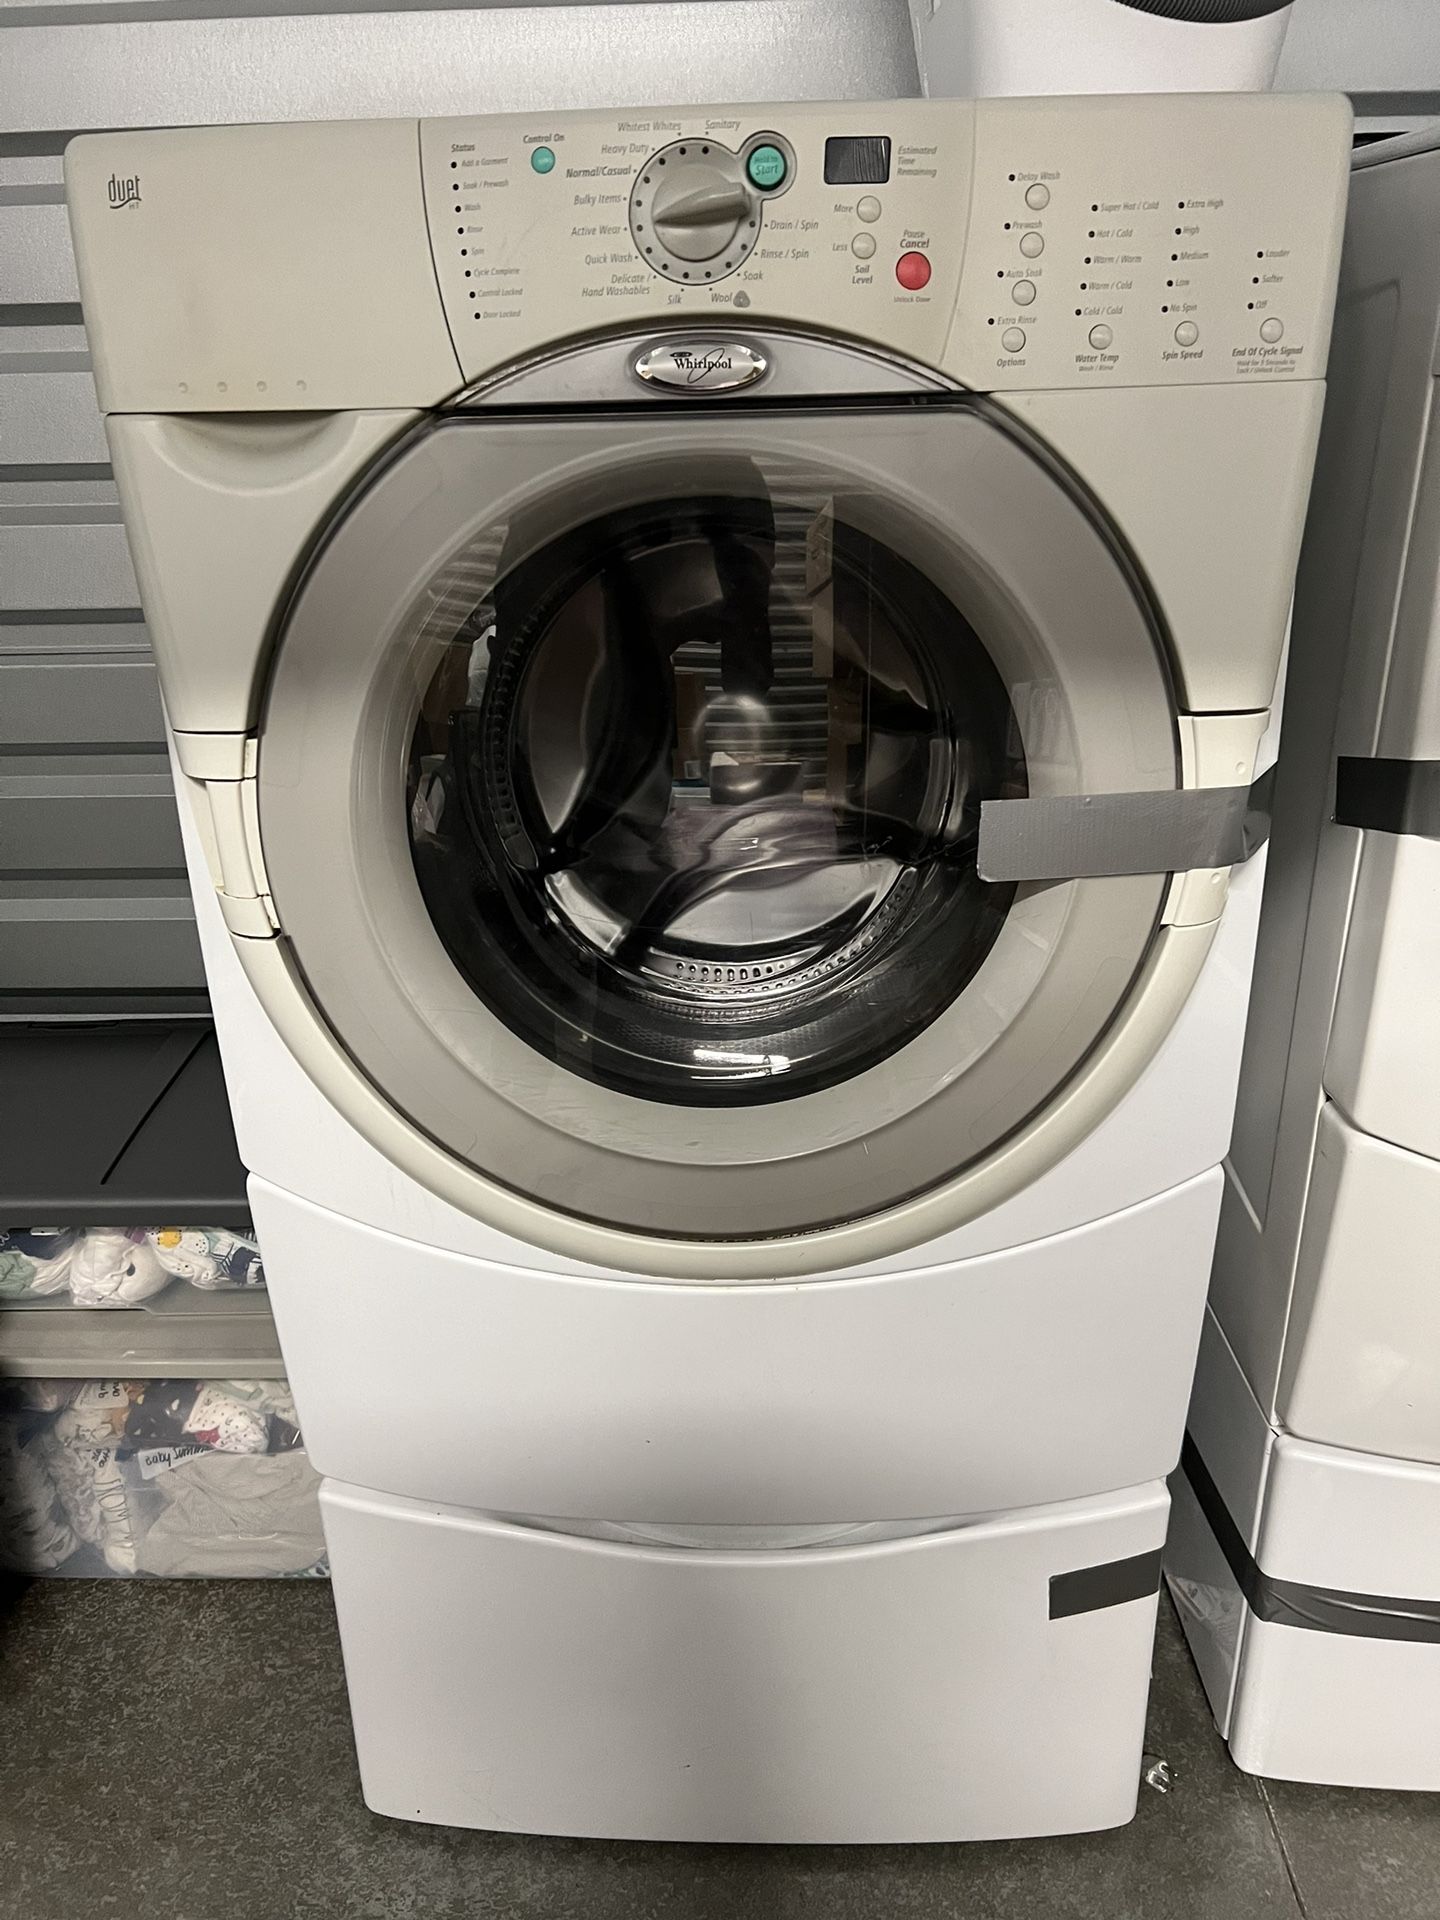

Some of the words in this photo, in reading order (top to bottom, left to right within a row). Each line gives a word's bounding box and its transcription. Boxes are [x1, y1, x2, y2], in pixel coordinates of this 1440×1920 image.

[618, 122, 650, 132] Whitest
[653, 120, 682, 132] Whites
[705, 120, 741, 131] Sanitary
[523, 134, 552, 144] Control
[553, 133, 566, 142] On
[451, 144, 475, 153] Status
[601, 144, 627, 155] Heavy
[629, 143, 650, 154] Duty
[898, 145, 938, 155] Estimated
[566, 165, 632, 178] Normal/Casual
[755, 164, 778, 176] Start
[897, 168, 938, 178] Remaining
[108, 173, 140, 203] duet
[574, 195, 596, 206] Bulky
[598, 194, 622, 204] Items
[1186, 200, 1206, 208] Extra
[1206, 200, 1224, 210] High
[833, 204, 854, 213] More
[1100, 203, 1122, 213] Super
[1122, 202, 1136, 211] Hot
[1142, 201, 1160, 210] Cold
[770, 220, 793, 230] Drain
[800, 219, 819, 232] Spin
[571, 226, 597, 236] Active
[599, 226, 622, 236] Wear
[903, 229, 926, 238] Pause
[1096, 230, 1110, 238] Hot
[1116, 228, 1134, 238] Cold
[832, 243, 848, 252] Less
[900, 238, 930, 249] Cancel
[760, 248, 784, 259] Rinse
[790, 248, 810, 260] Spin
[1180, 252, 1209, 260] Medium
[585, 254, 607, 266] Quick
[610, 253, 633, 264] Wash
[1094, 256, 1114, 264] Warm
[1120, 255, 1142, 264] Warm
[474, 268, 490, 278] Cycle
[490, 268, 520, 276] Complete
[854, 264, 870, 274] Soil
[611, 274, 645, 284] Delicate
[743, 270, 764, 281] Soak
[852, 275, 874, 285] Level
[1088, 282, 1110, 290] Warm
[1116, 280, 1133, 290] Cold
[1176, 279, 1190, 287] Low
[501, 288, 523, 296] Locked
[582, 287, 604, 298] Hand
[606, 286, 650, 296] Washables
[667, 295, 682, 306] Silk
[711, 293, 733, 303] Wool
[1170, 304, 1180, 312] No
[1182, 303, 1198, 313] Spin
[1255, 300, 1268, 309] Off
[1084, 306, 1100, 316] Cold
[1106, 305, 1124, 315] Cold
[997, 316, 1016, 326] Extra
[1018, 316, 1037, 324] Rinse
[1162, 350, 1178, 362] Spin
[1180, 350, 1204, 360] Speed
[1232, 348, 1246, 358] End
[1248, 347, 1258, 356] Of
[1258, 347, 1278, 358] Cycle
[1280, 346, 1304, 358] Signal
[996, 357, 1026, 368] Options
[1076, 354, 1098, 363] Water
[1100, 353, 1120, 364] Temp
[674, 358, 732, 372] Whirlpool
